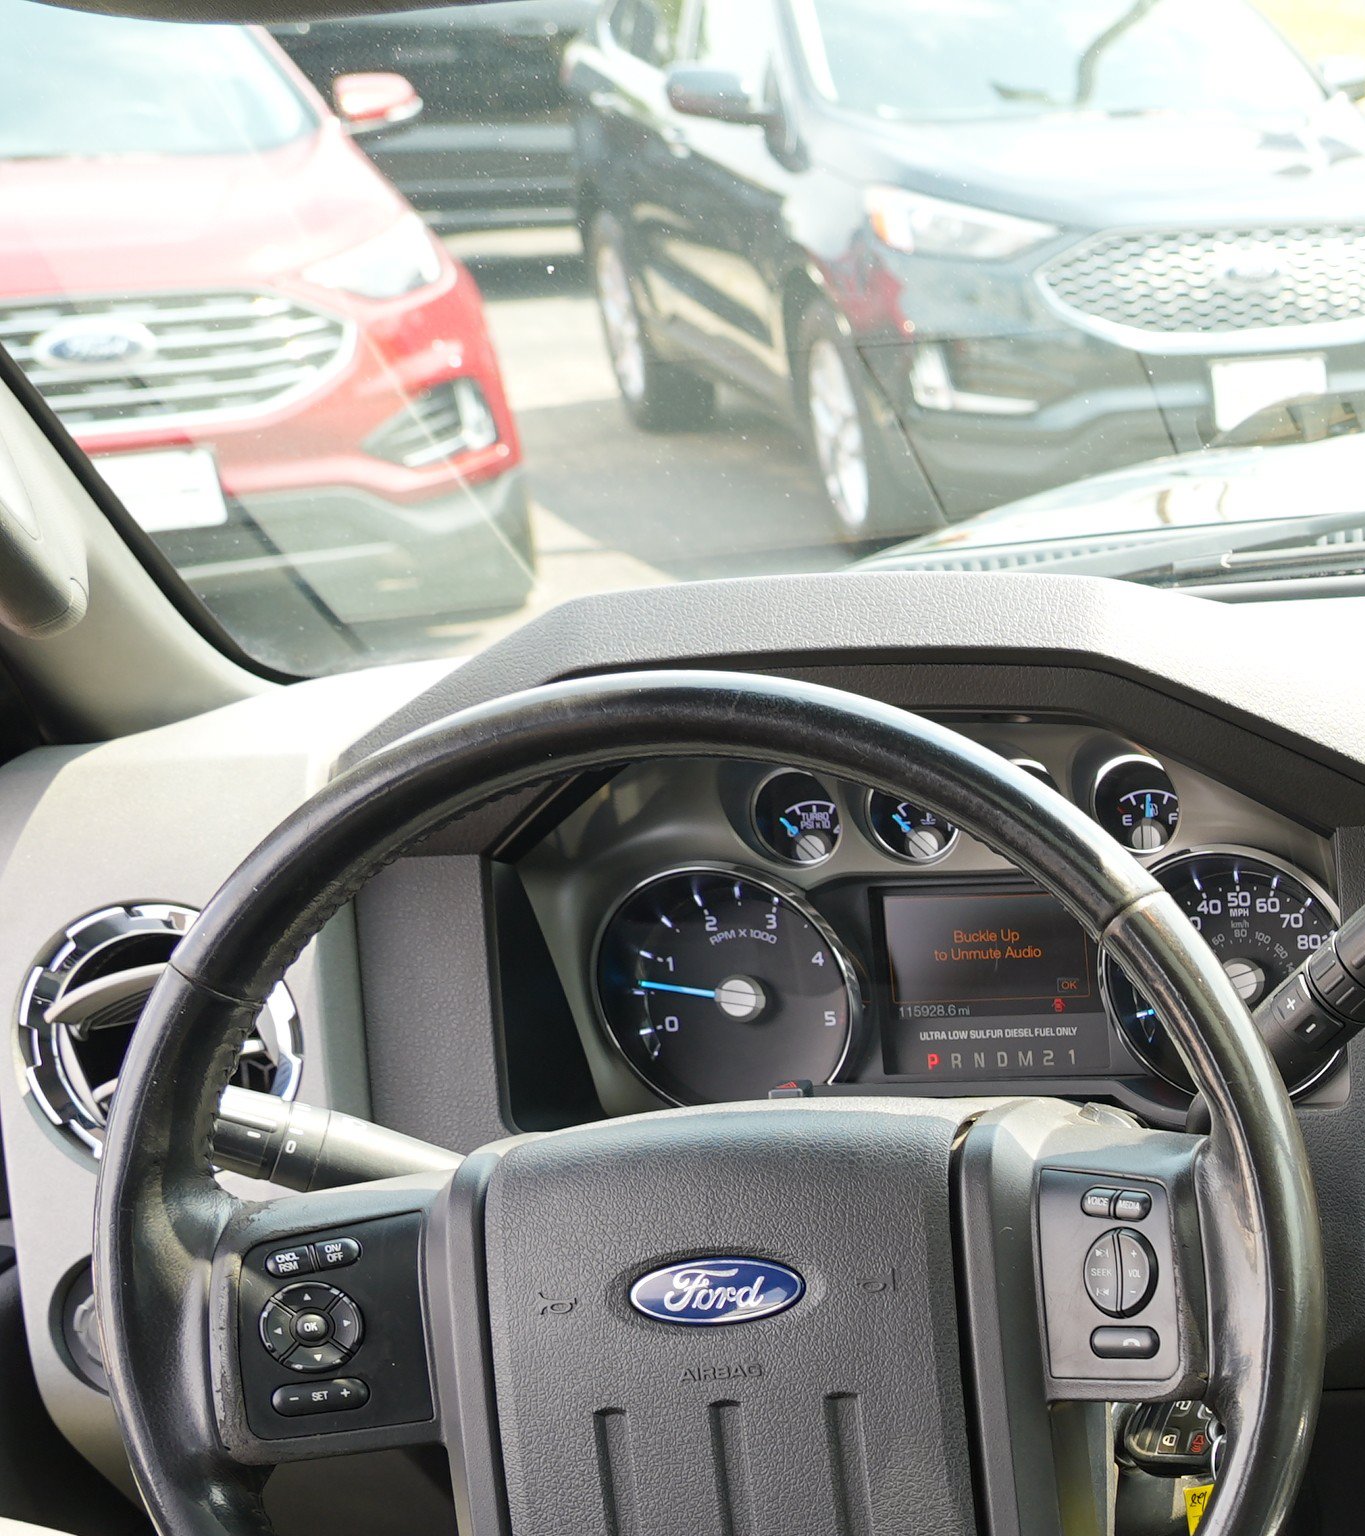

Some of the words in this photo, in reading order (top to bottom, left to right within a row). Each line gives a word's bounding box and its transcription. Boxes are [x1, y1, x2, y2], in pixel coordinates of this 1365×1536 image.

[801, 812, 829, 821] TURBO
[1122, 814, 1132, 826] E
[1168, 814, 1178, 825] F
[800, 820, 815, 829] PSI
[821, 820, 830, 829] 10
[1227, 891, 1251, 907] 50
[1256, 897, 1280, 913] 60
[1197, 899, 1221, 914] 40
[1230, 908, 1249, 917] MPH
[705, 916, 717, 931] 2
[766, 914, 777, 929] 3
[1230, 919, 1250, 929] km/h
[1280, 913, 1303, 929] 70
[709, 930, 737, 945] RPM
[738, 929, 747, 938] X
[749, 929, 777, 944] 1000
[953, 929, 997, 944] Buckle
[1000, 929, 1020, 944] Up
[1234, 929, 1247, 938] 80
[1254, 931, 1271, 944] 100
[1297, 934, 1321, 950] 80
[934, 949, 948, 961] to
[951, 947, 1001, 961] Unmute
[1004, 946, 1042, 959] Audio
[1274, 943, 1288, 959] 120
[665, 957, 674, 971] 1
[811, 952, 824, 966] 4
[1061, 980, 1078, 990] OK
[899, 1004, 957, 1018] 115928.6
[958, 1006, 971, 1016] mi
[665, 1016, 679, 1032] 0
[824, 1011, 836, 1026] 5
[920, 1031, 947, 1041] ULTRA
[948, 1030, 968, 1040] LOW
[969, 1029, 1003, 1039] SULFUR
[1005, 1028, 1034, 1038] DIESEL
[1034, 1027, 1056, 1037] FUEL
[1056, 1026, 1078, 1036] ONLY
[927, 1053, 940, 1069] P
[951, 1053, 962, 1069] R
[974, 1052, 985, 1067] N
[997, 1052, 1008, 1067] D
[1018, 1051, 1033, 1067] M
[1043, 1050, 1054, 1066] 2
[1068, 1049, 1076, 1064] 1
[1087, 1196, 1109, 1207] VOICE
[1119, 1199, 1140, 1211] MEDIA
[325, 1243, 342, 1254] ON/
[275, 1252, 299, 1264] CNCL
[326, 1252, 344, 1263] OFF
[279, 1261, 299, 1273] RSM
[1091, 1268, 1112, 1277] SEEK
[1128, 1269, 1141, 1278] VOL
[663, 1277, 765, 1312] Ford
[304, 1321, 318, 1333] OK
[682, 1363, 763, 1382] AIRBAG
[311, 1389, 328, 1401] SET
